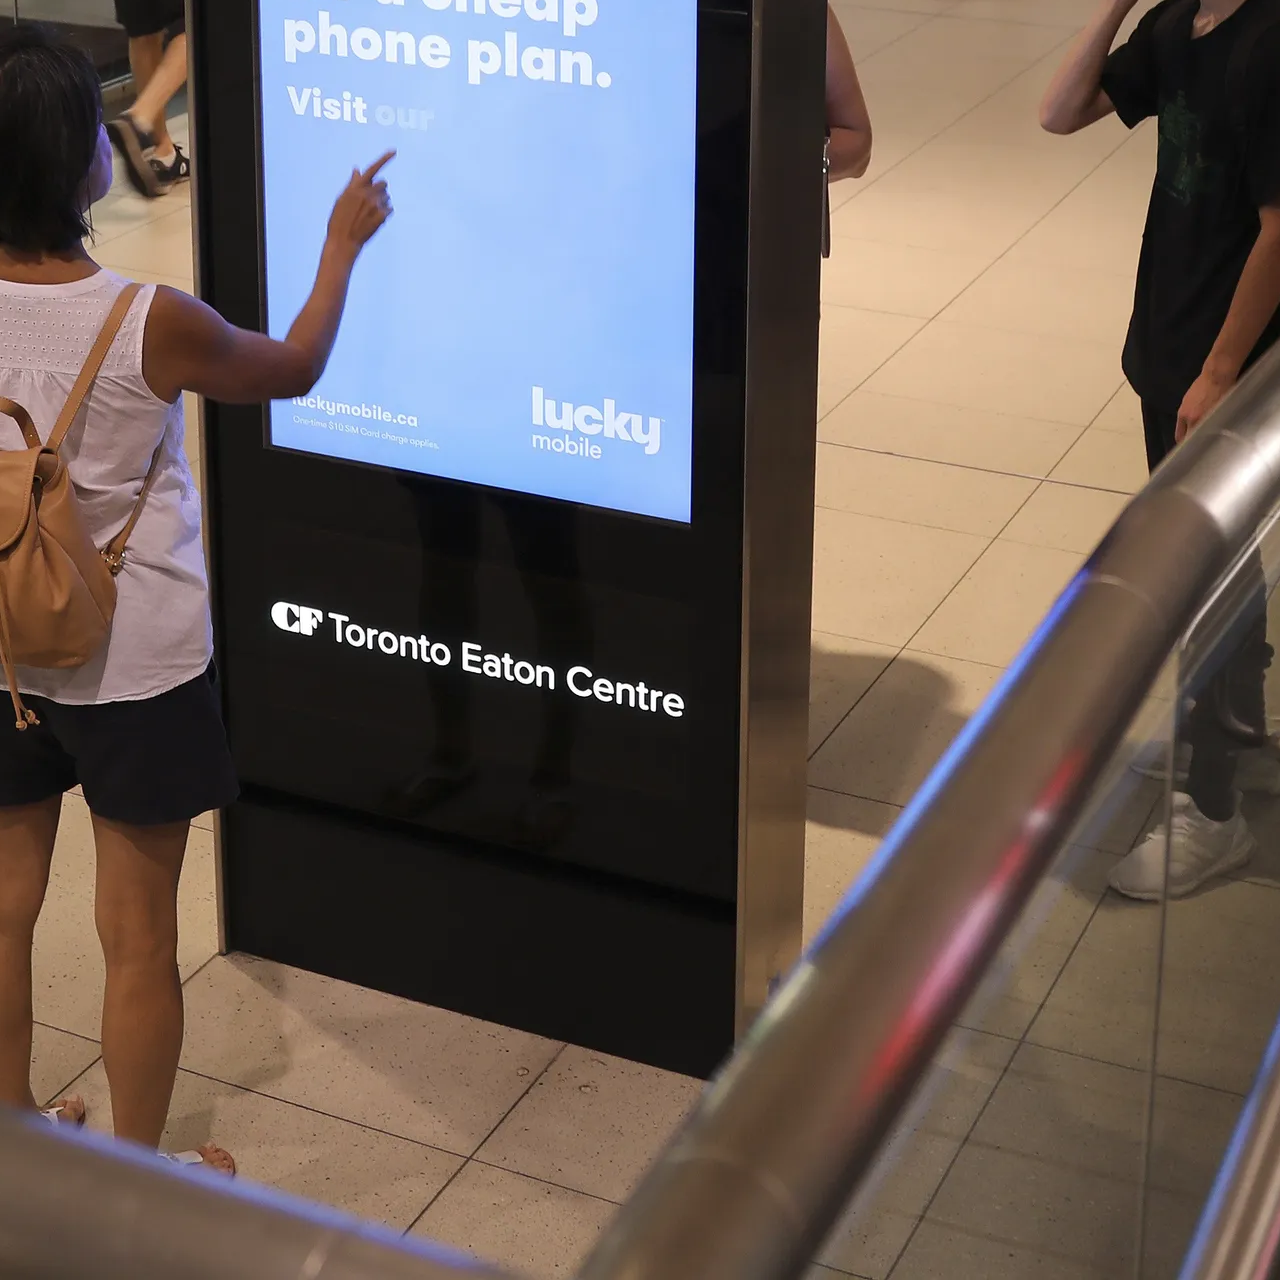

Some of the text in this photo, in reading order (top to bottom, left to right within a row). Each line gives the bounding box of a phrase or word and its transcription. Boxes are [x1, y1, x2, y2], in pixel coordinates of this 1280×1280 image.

[283, 11, 613, 88] phone plan.
[286, 85, 435, 132] Visit our
[328, 421, 344, 433] $10
[345, 424, 360, 435] SIM
[360, 427, 380, 439] Card
[381, 432, 409, 445] charge
[532, 385, 661, 455] lucky
[533, 433, 602, 459] mobile
[328, 612, 451, 667] Toronto
[461, 641, 556, 691] Eaton
[566, 666, 685, 718] Centre
